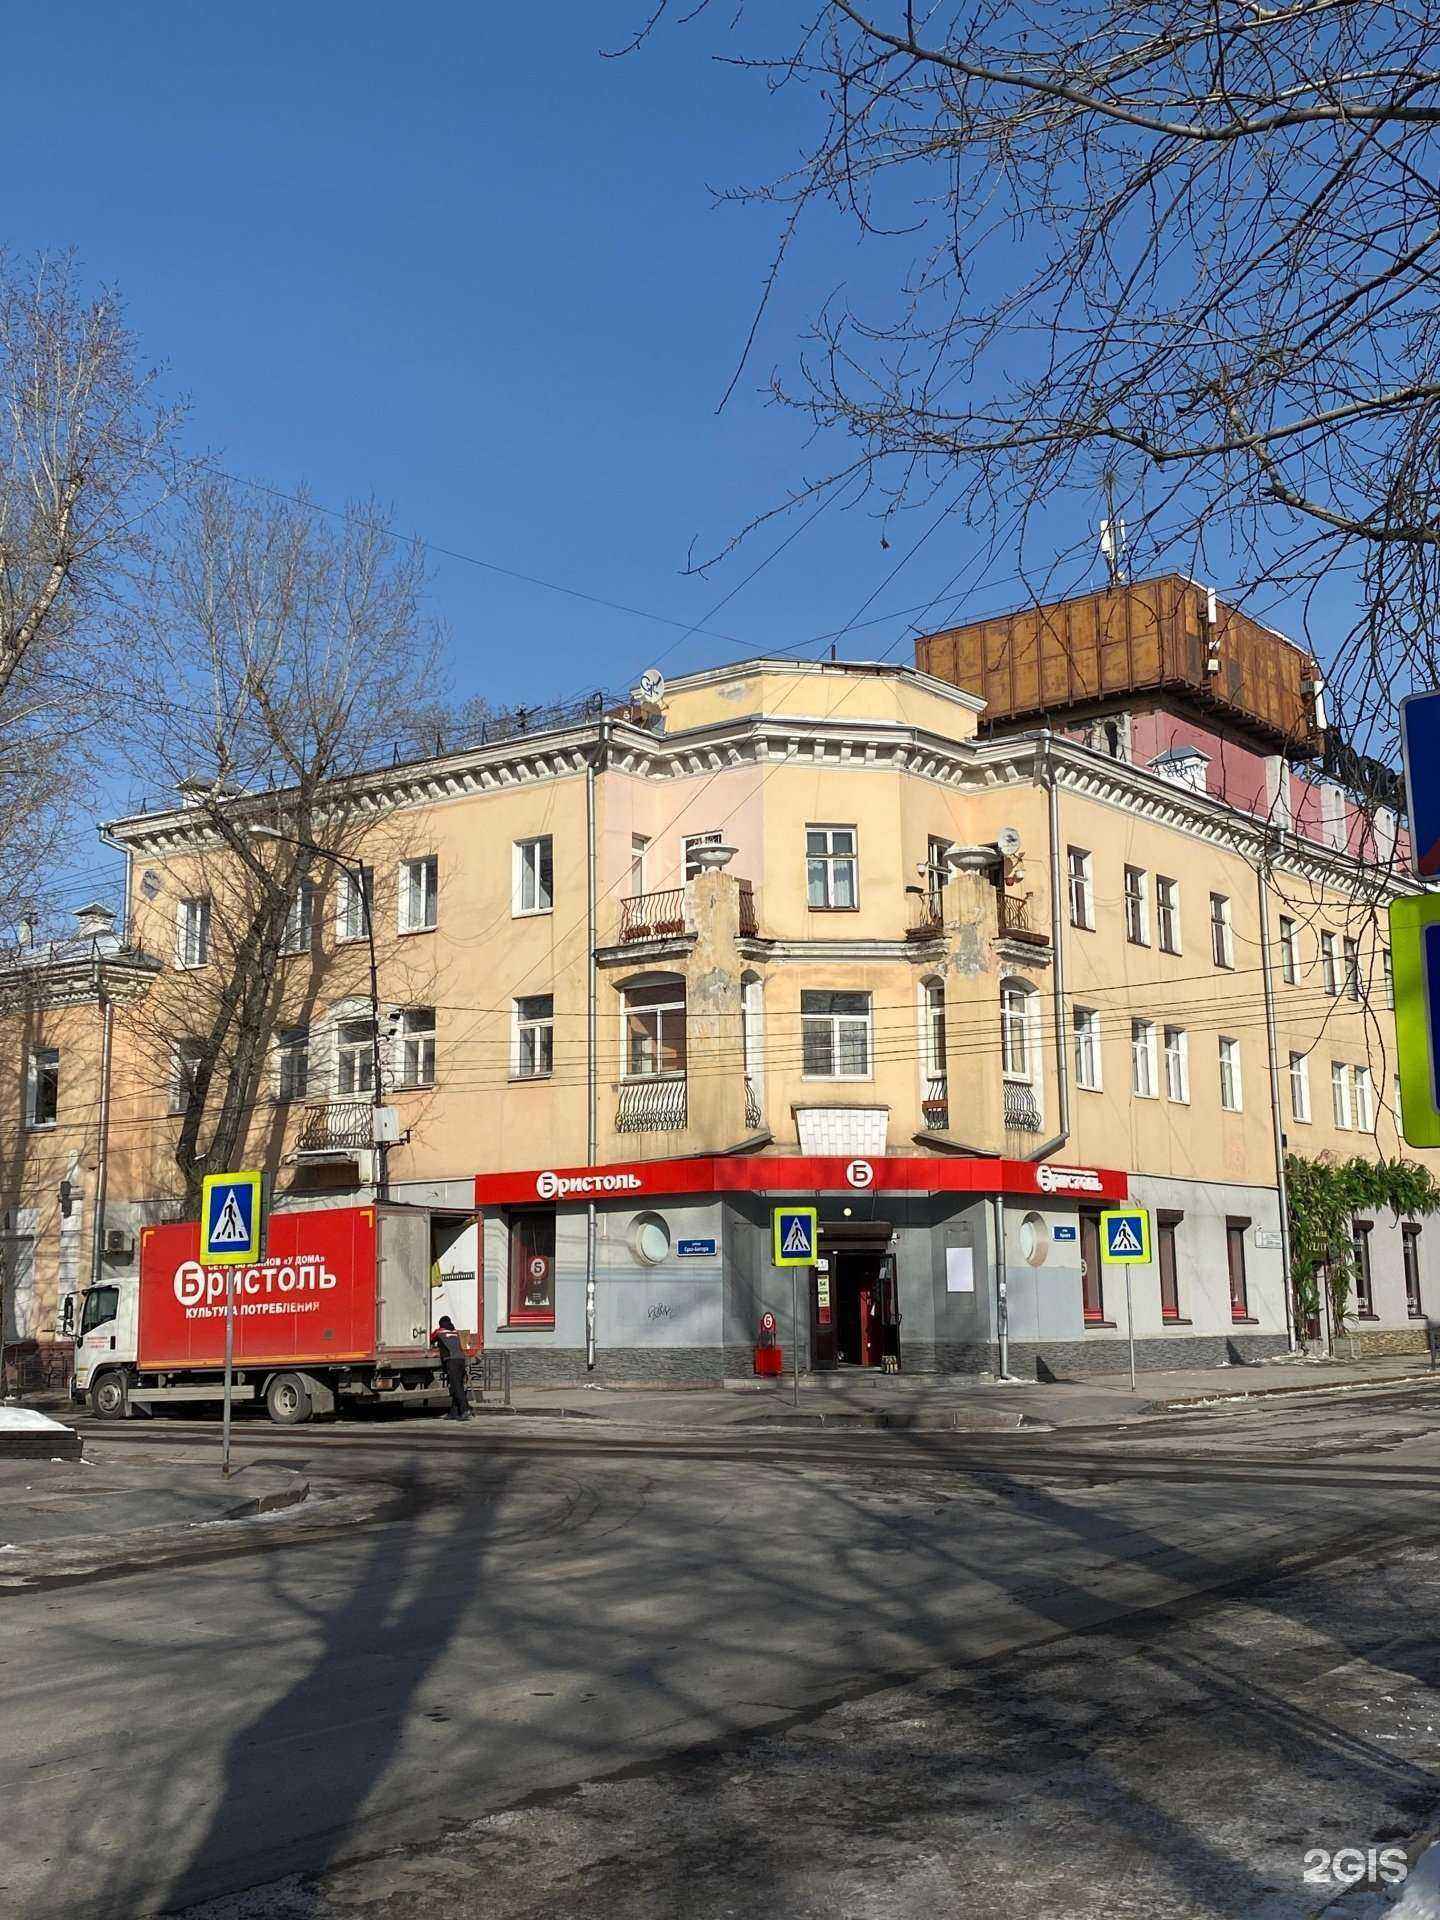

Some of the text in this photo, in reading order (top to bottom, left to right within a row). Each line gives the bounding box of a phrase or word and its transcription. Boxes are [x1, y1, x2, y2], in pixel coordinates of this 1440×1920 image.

[536, 1172, 642, 1199] Бристоль
[173, 1260, 337, 1306] Бристоль
[240, 1301, 321, 1316] ПОТРЕБЛЕНИЯ
